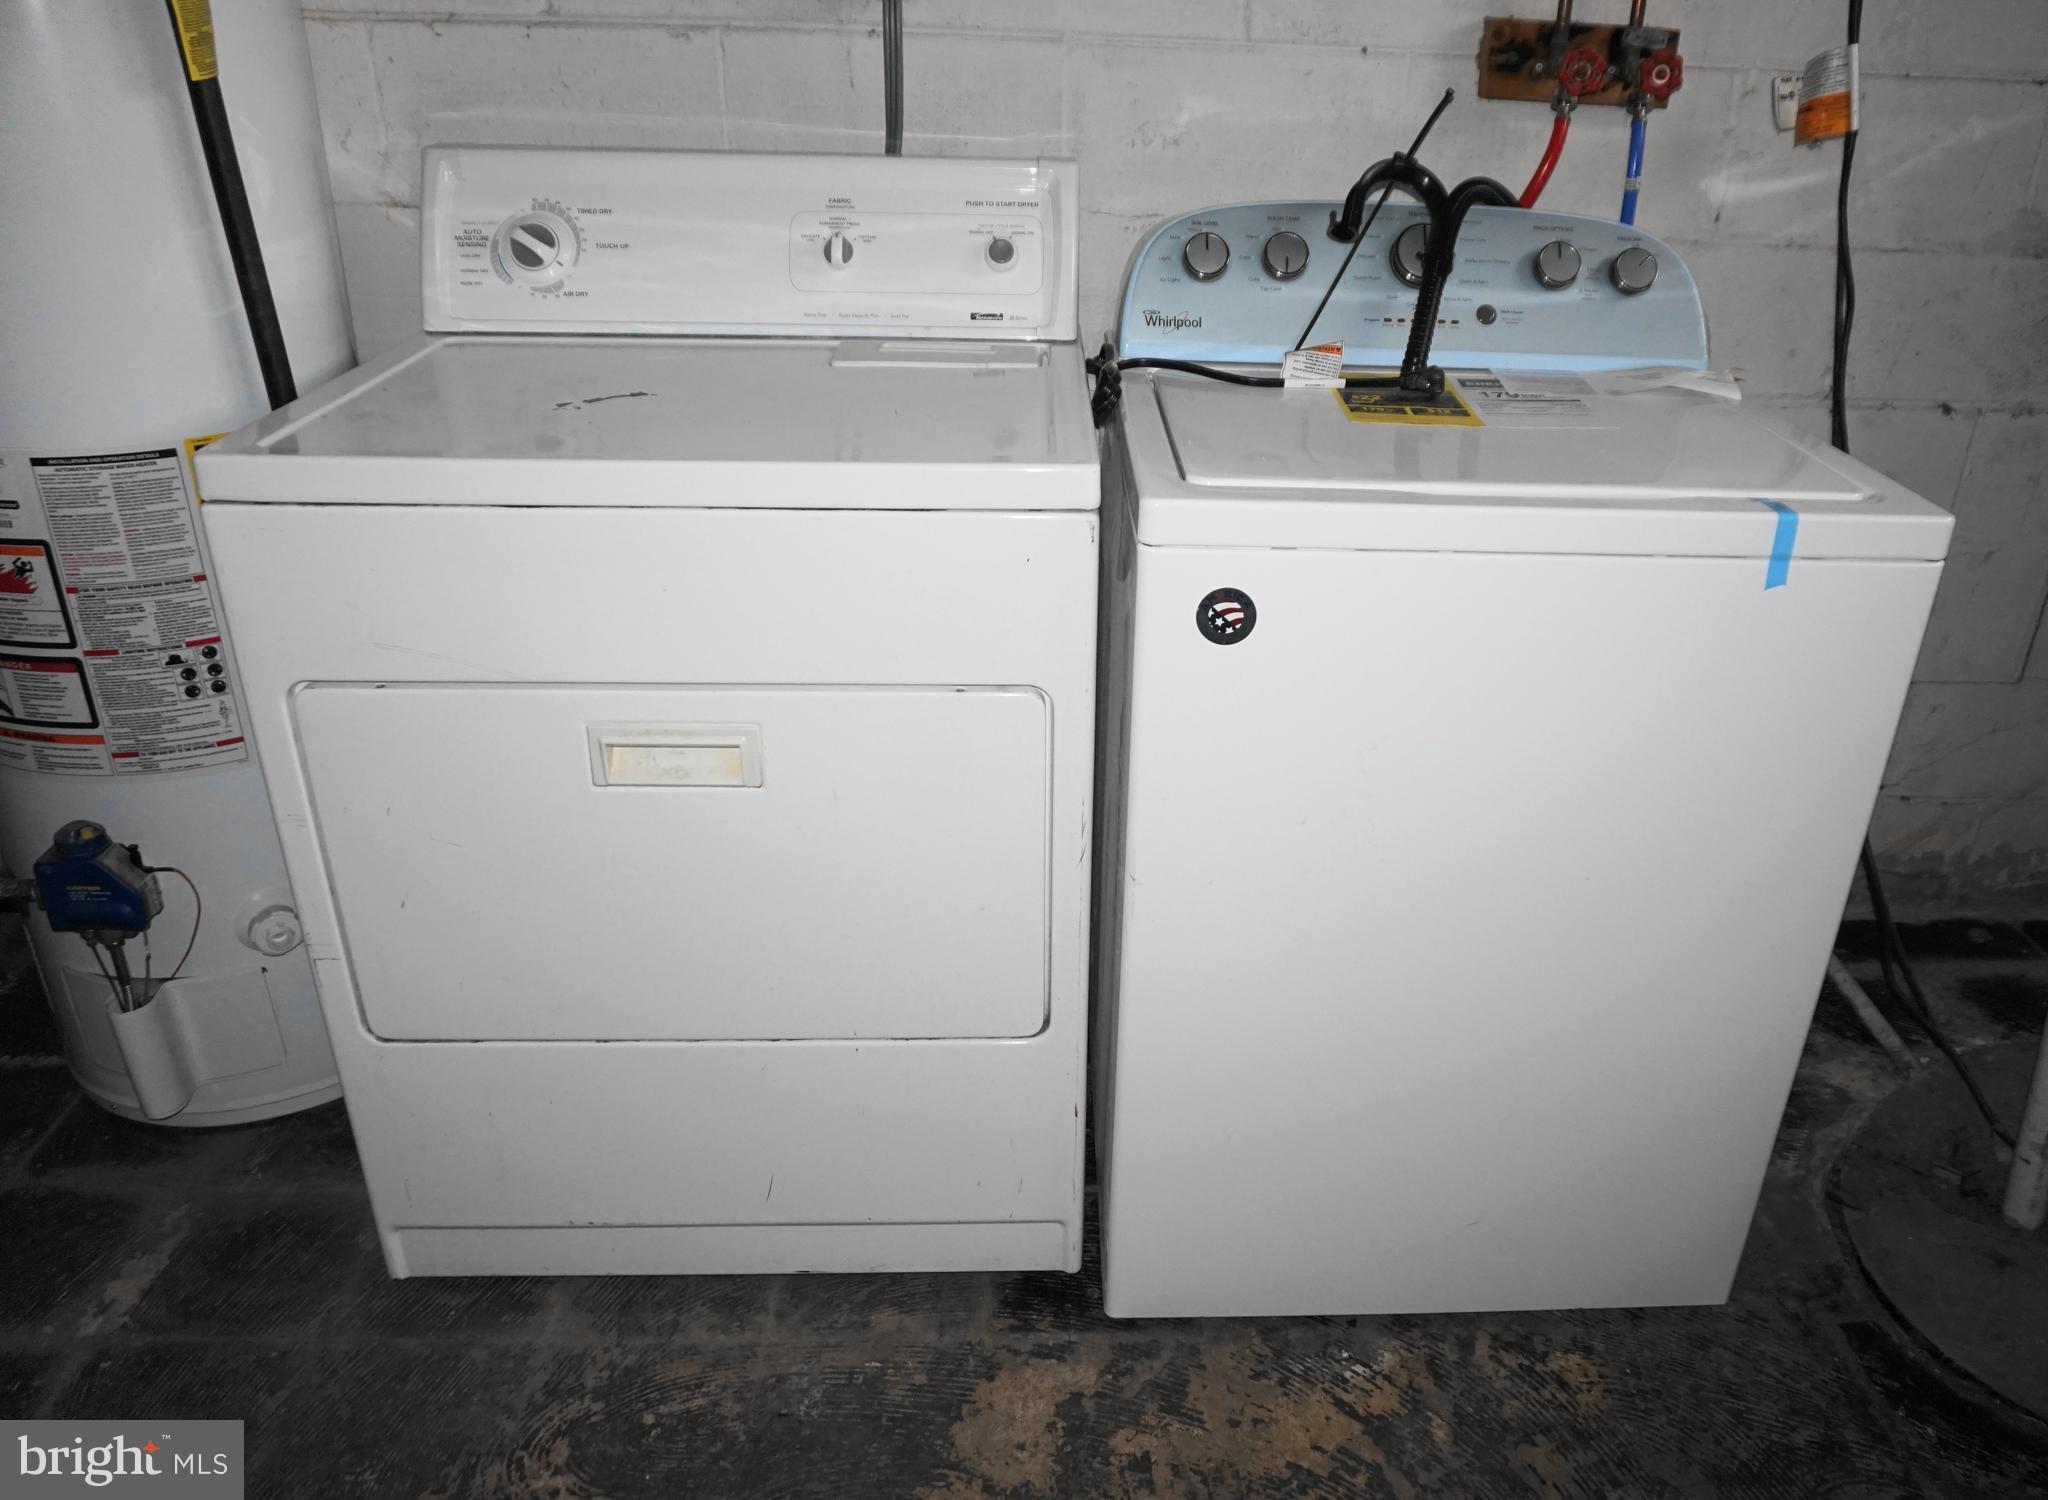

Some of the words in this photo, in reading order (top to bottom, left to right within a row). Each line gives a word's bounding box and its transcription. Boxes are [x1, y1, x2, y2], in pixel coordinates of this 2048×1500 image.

[577, 207, 598, 215] TIMED
[599, 207, 613, 215] DRY
[1145, 315, 1202, 330] Whirlpool
